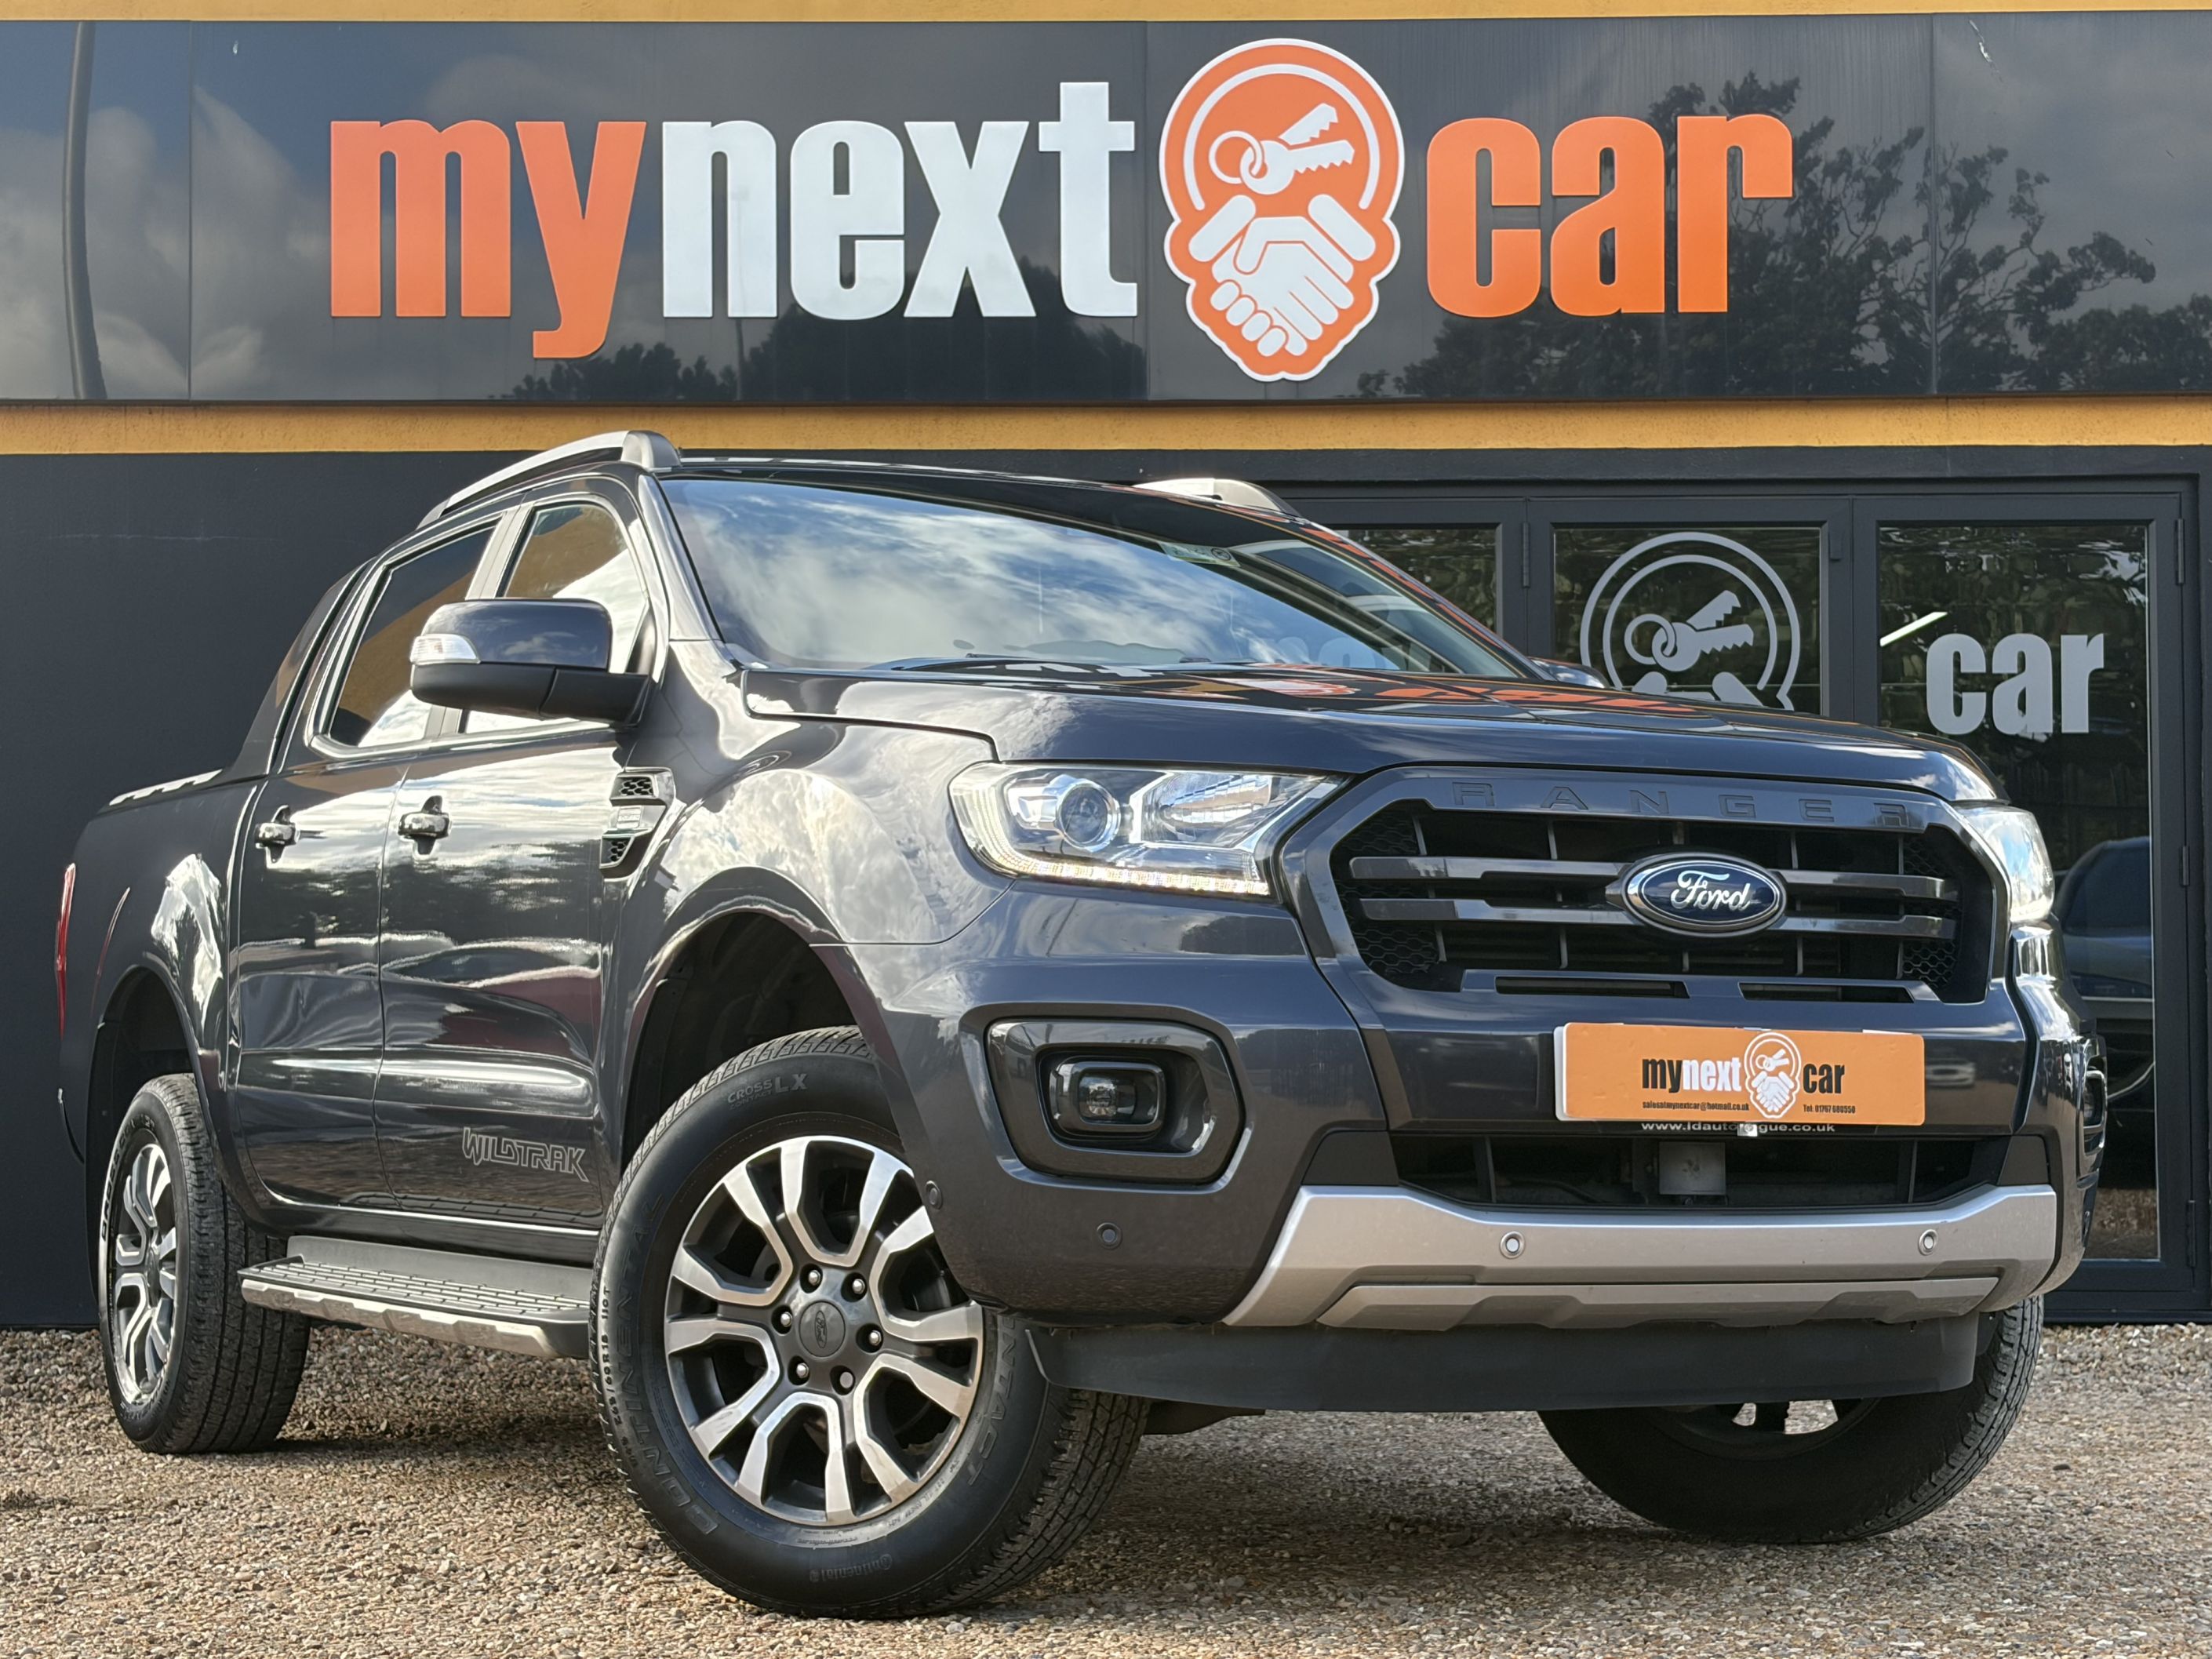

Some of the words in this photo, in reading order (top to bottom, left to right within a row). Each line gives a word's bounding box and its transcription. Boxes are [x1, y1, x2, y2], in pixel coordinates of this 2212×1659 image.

[1426, 114, 1793, 318] car
[1926, 633, 2105, 737] car
[1451, 781, 1910, 828] RANGER
[1671, 870, 1751, 911] Ford
[727, 1079, 773, 1104] CROSS
[774, 1073, 809, 1093] LX
[1803, 1063, 1845, 1093] car
[462, 1126, 589, 1183] WILDTRAK
[616, 1192, 719, 1535] CONTINENTAL
